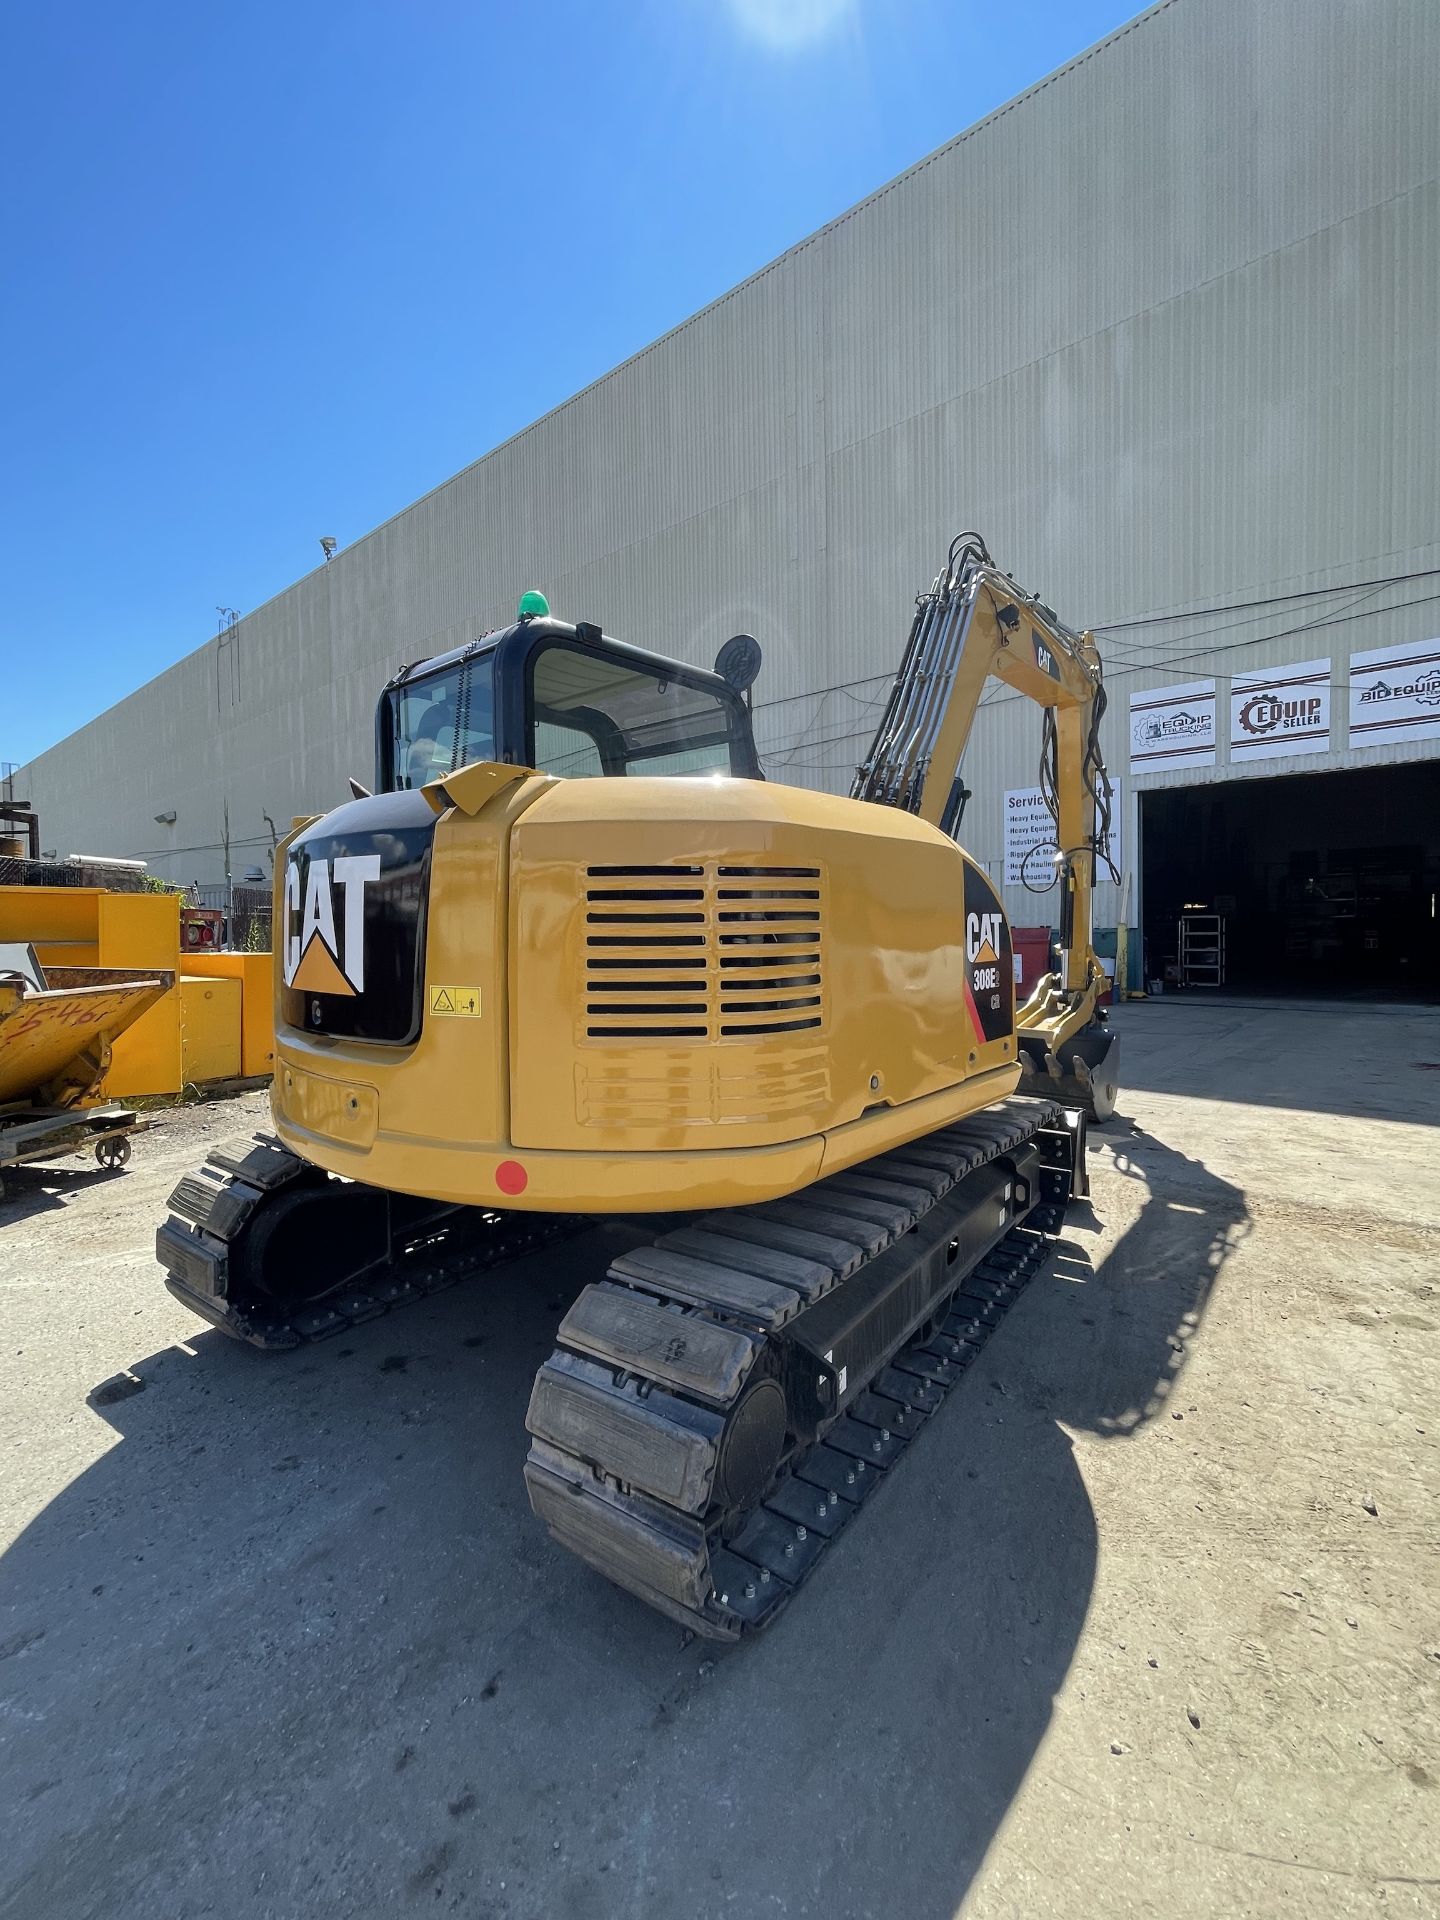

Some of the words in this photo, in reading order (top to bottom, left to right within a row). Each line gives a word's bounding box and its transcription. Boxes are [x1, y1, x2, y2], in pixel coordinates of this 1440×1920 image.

[1038, 646, 1051, 673] CAT
[1360, 685, 1391, 702] BID
[1393, 680, 1440, 696] EQUIP
[1257, 698, 1321, 723] EQUIP
[1162, 714, 1212, 729] EQUIP
[1163, 723, 1212, 734] TRUCKING
[1283, 715, 1321, 728] SELLER
[1008, 794, 1044, 809] Servic
[1010, 837, 1041, 846] Industrial
[1030, 860, 1056, 869] Hauling
[282, 854, 381, 993] CAT
[966, 912, 1003, 963] CAT
